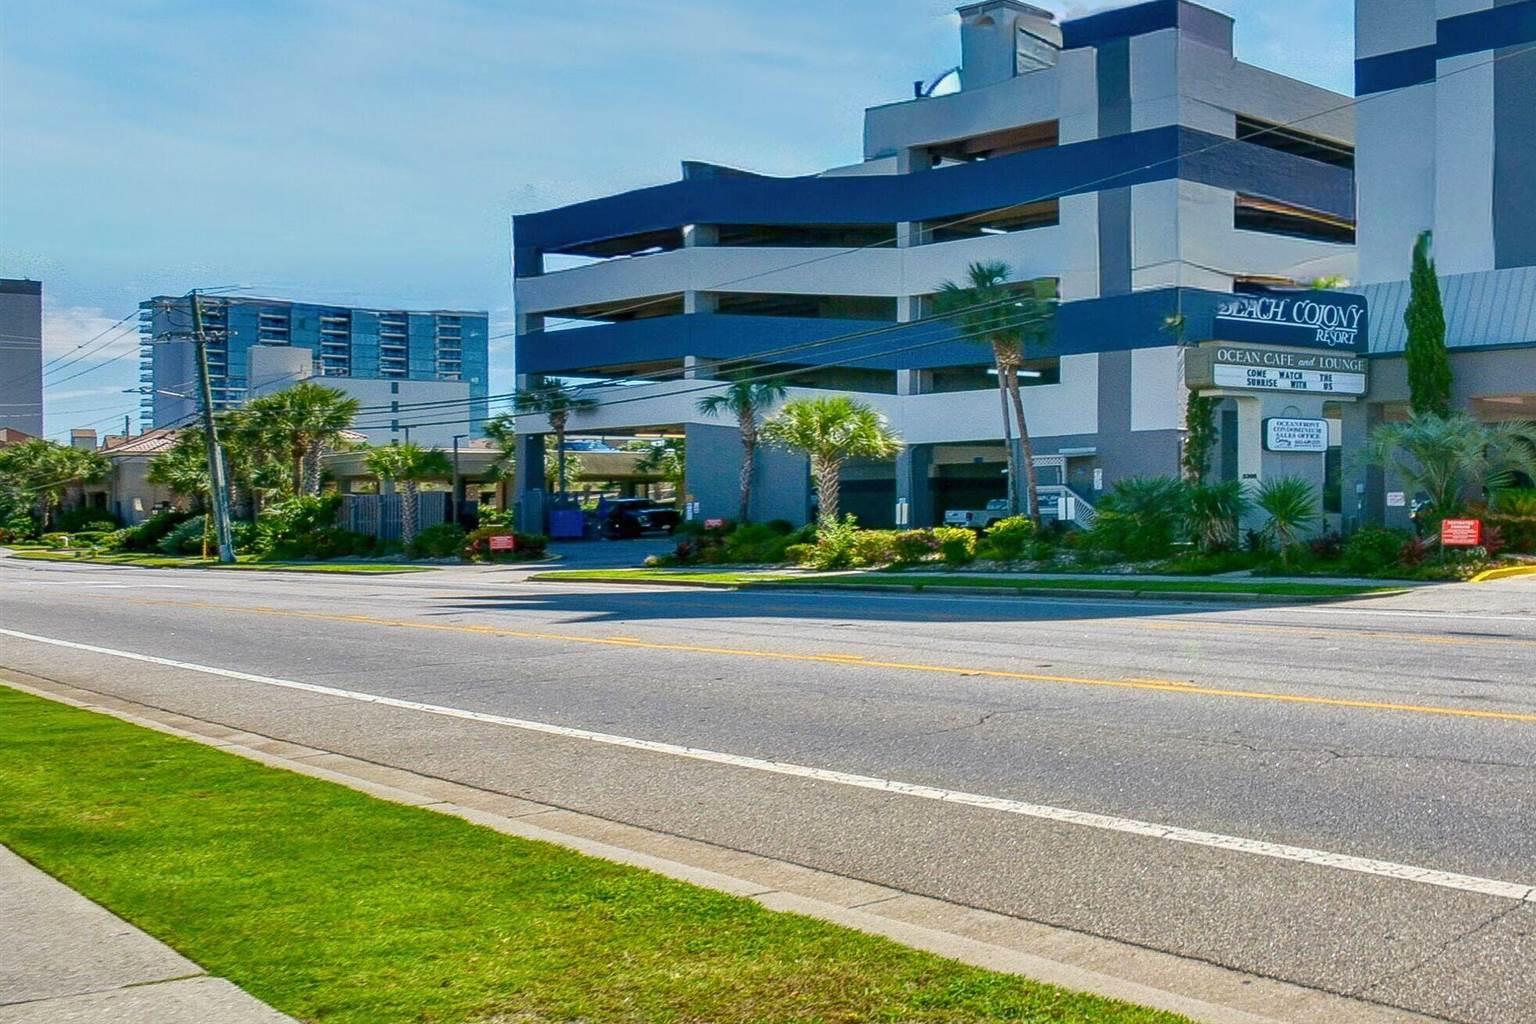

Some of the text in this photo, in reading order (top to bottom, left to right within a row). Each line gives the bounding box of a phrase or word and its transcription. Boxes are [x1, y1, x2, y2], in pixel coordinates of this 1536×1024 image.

[1293, 300, 1364, 330] COLONY
[1315, 329, 1357, 346] RESORT
[1217, 348, 1260, 364] OCEAN
[1263, 352, 1294, 366] CAFE
[1297, 356, 1316, 367] and
[1247, 369, 1333, 382] COME WATCH THE
[1247, 378, 1278, 387] SUNRISE
[1290, 380, 1307, 389] WITH
